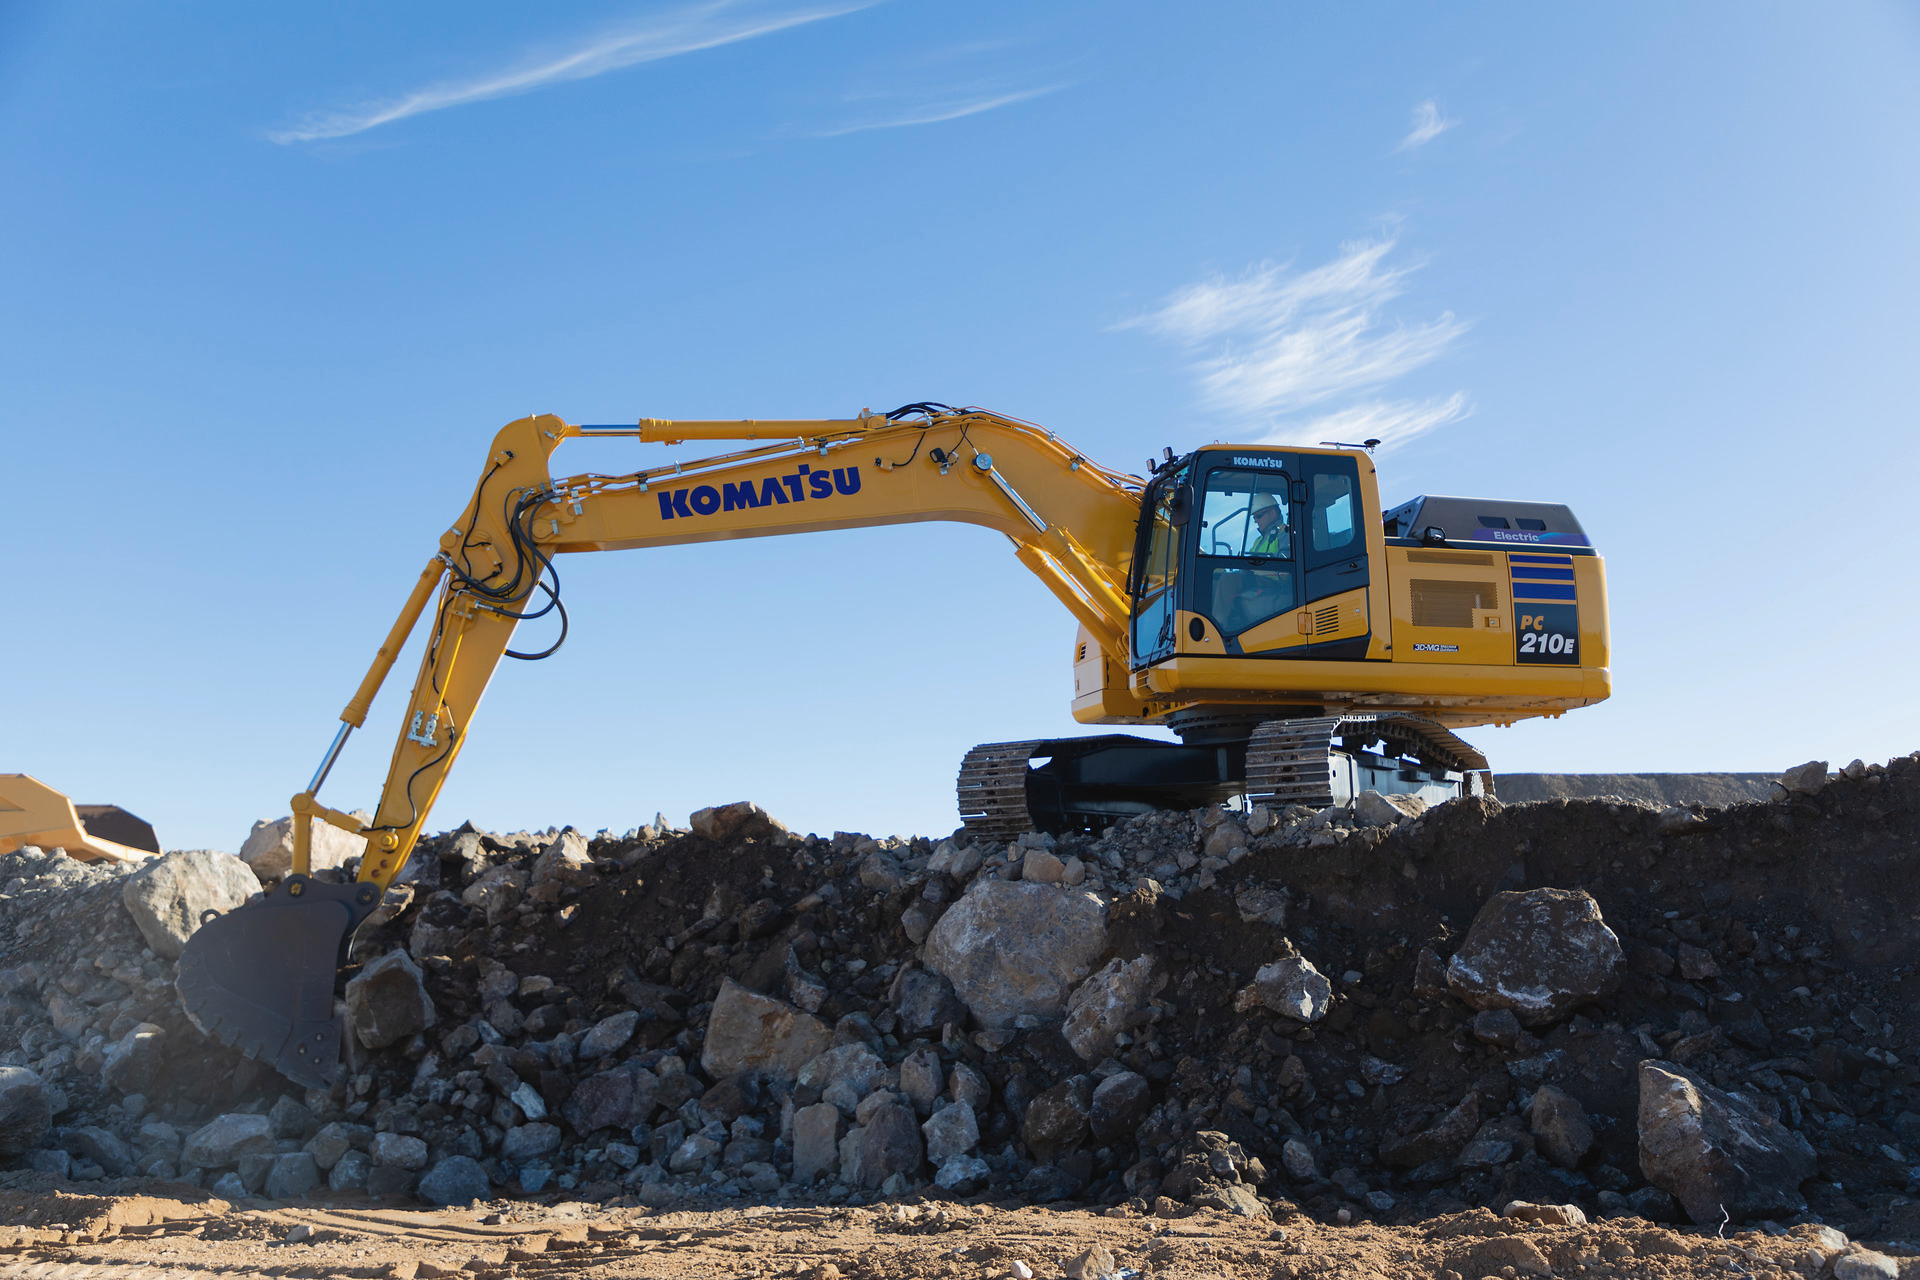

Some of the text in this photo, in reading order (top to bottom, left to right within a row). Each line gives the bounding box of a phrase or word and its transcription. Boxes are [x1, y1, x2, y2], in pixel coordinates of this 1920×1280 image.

[1233, 456, 1283, 468] KOMATSU
[657, 464, 861, 520] KOMATSU
[1493, 531, 1540, 542] Electric
[1520, 615, 1544, 630] PC
[1414, 643, 1440, 652] 3D-MG
[1519, 632, 1575, 654] 210E
